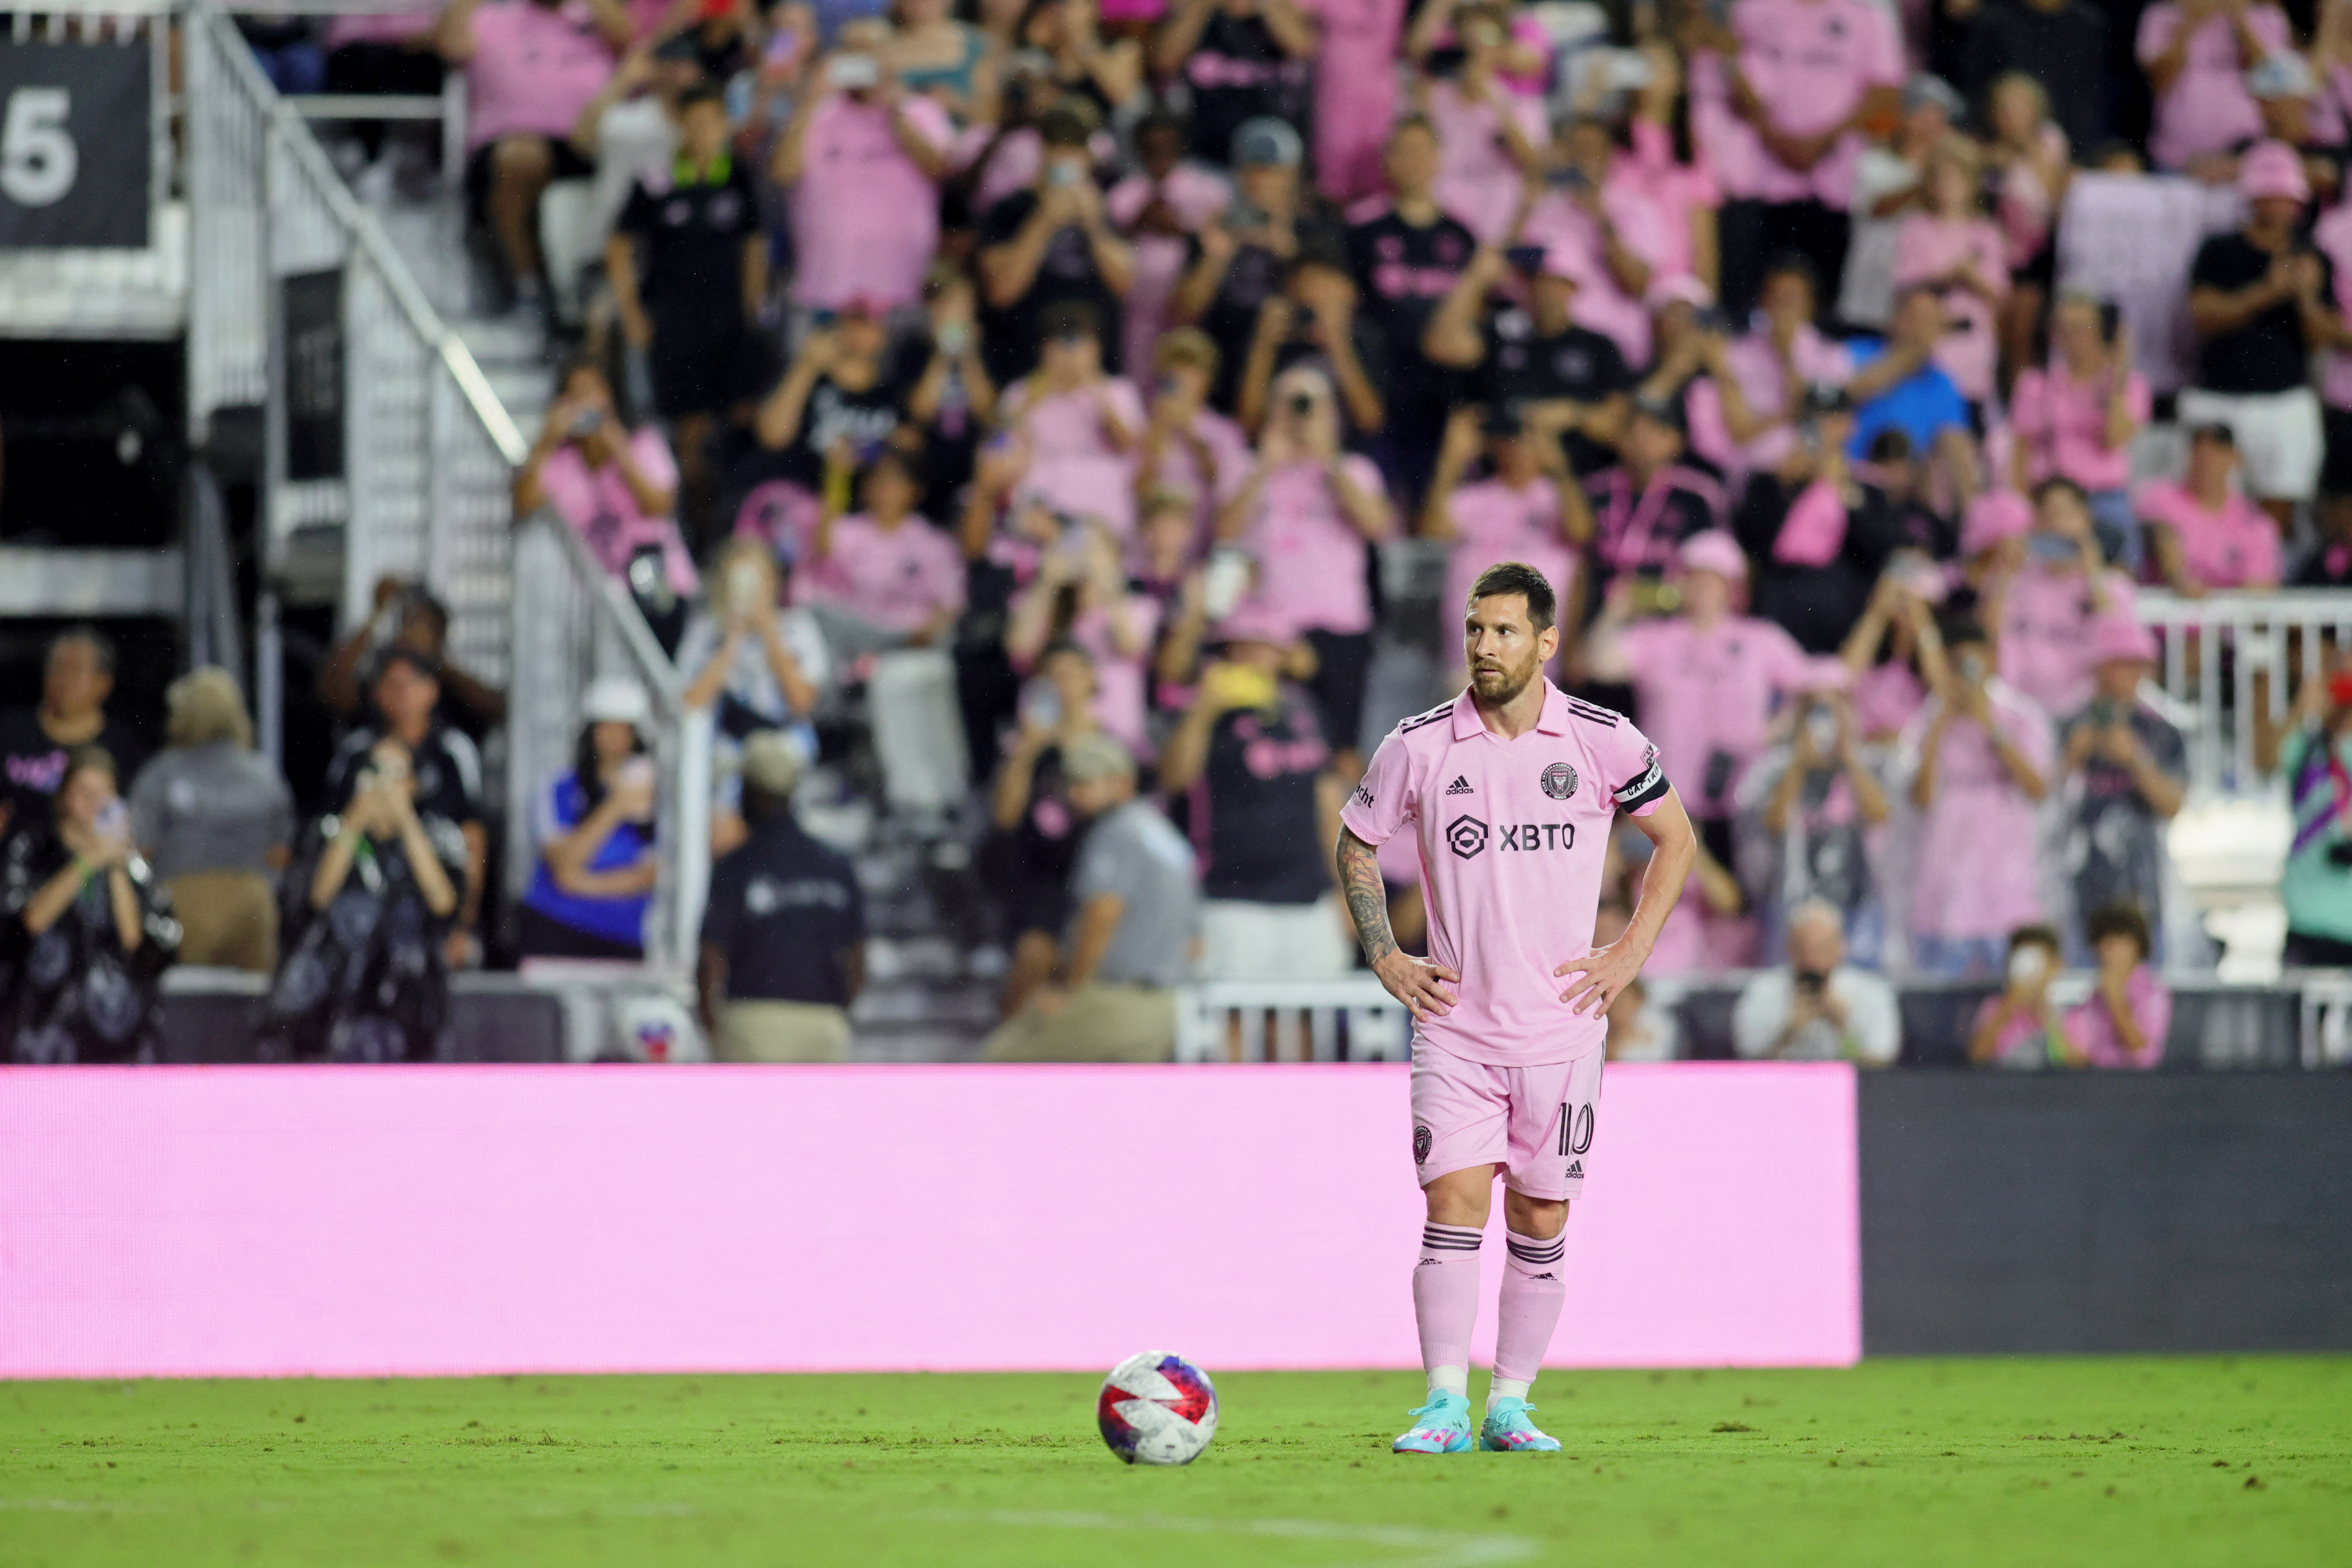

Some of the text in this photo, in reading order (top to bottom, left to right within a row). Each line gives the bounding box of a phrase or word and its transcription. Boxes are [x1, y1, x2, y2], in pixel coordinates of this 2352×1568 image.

[0, 84, 79, 206] 5
[1643, 748, 1652, 761] MLS
[1542, 763, 1572, 780] INTERNACIONAL
[1446, 786, 1474, 795] adidas
[1499, 823, 1575, 851] XBTO
[1558, 1101, 1594, 1156] 10
